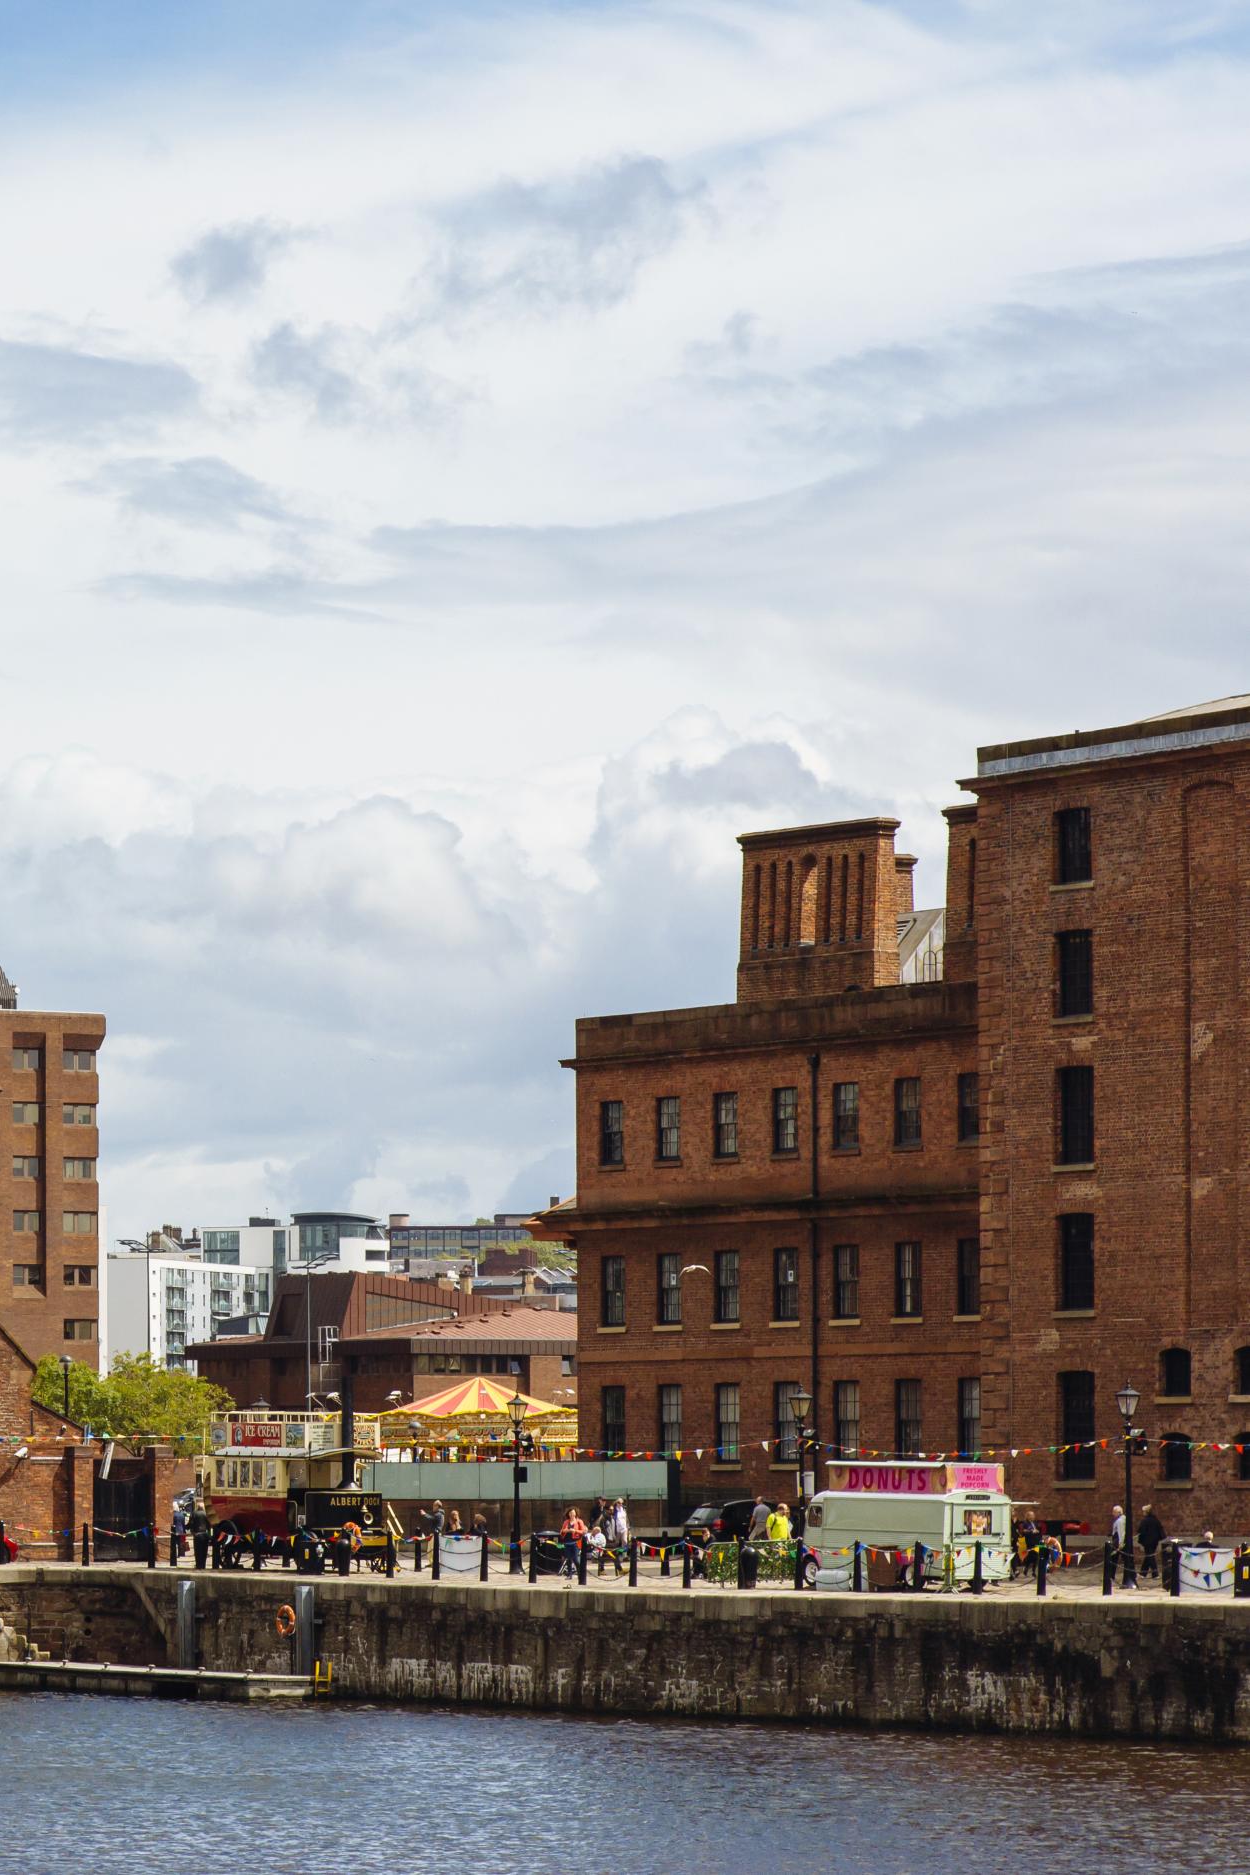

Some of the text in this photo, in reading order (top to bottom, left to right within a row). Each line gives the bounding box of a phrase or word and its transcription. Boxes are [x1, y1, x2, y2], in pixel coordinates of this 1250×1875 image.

[245, 1425, 281, 1438] ICE CREAM
[848, 1468, 927, 1491] DONUTS
[330, 1497, 361, 1506] ALBERT
